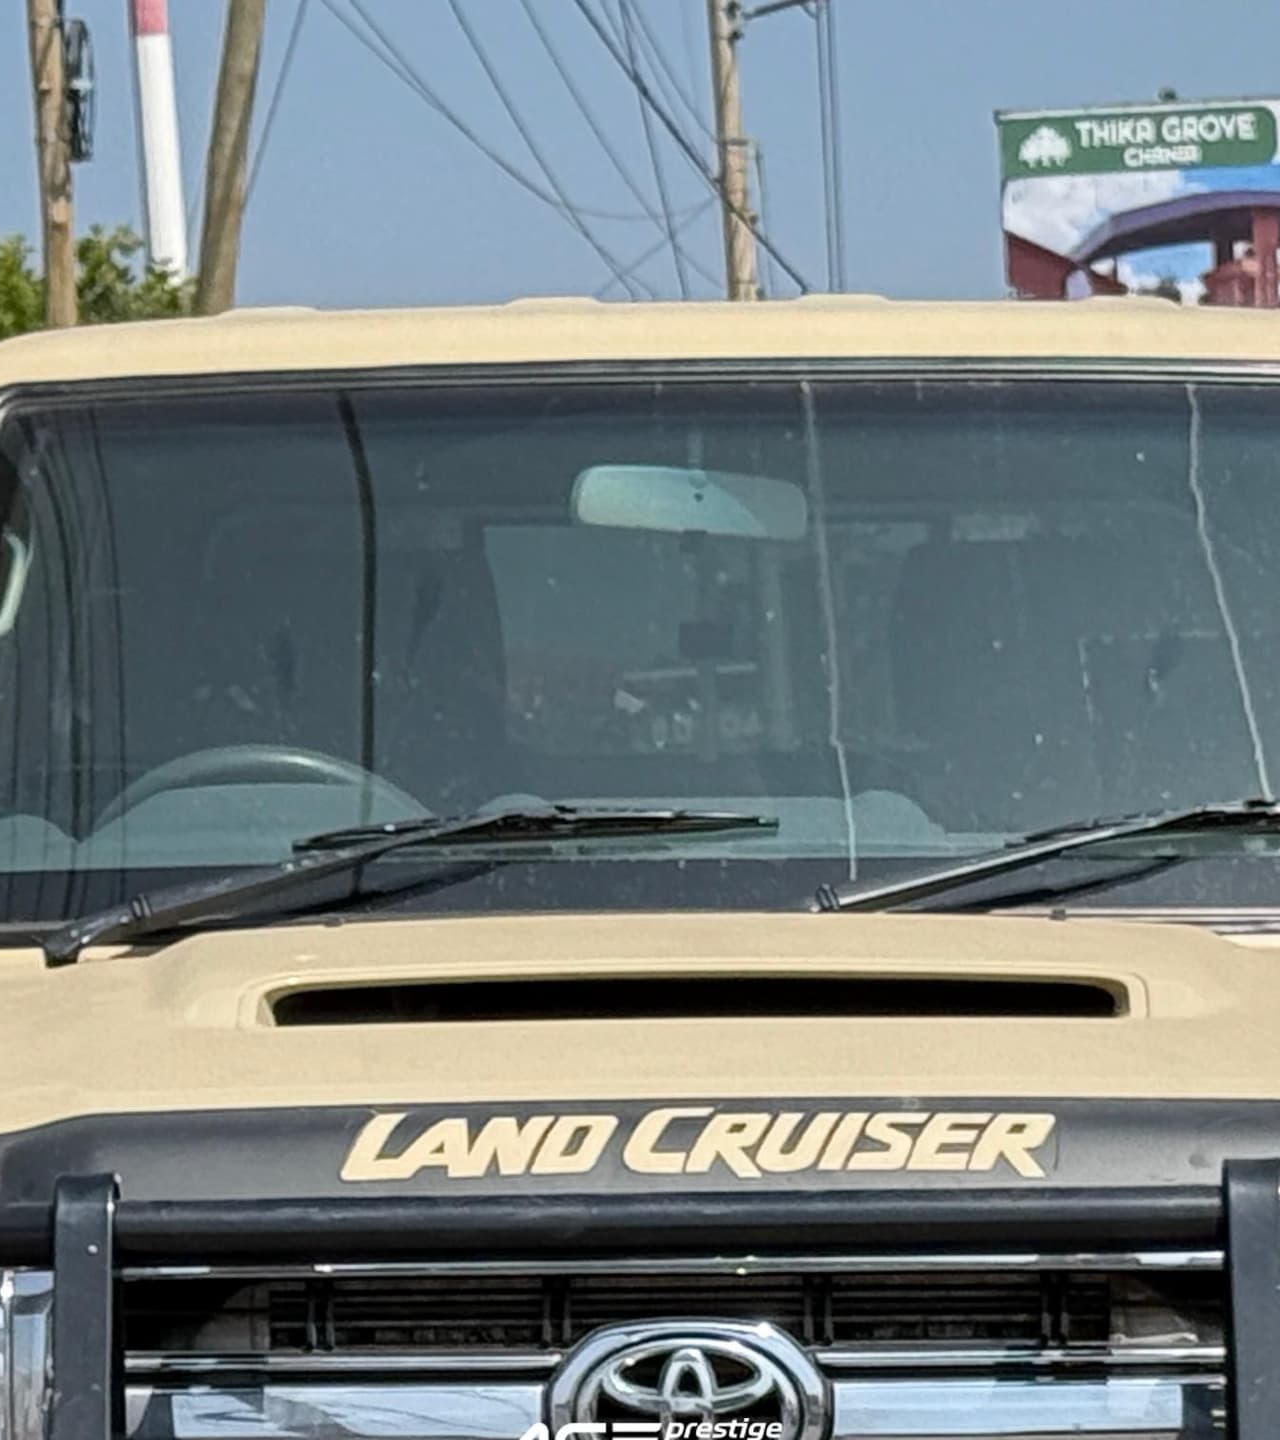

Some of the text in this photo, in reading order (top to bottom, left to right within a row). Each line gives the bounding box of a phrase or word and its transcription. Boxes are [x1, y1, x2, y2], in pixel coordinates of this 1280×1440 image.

[1074, 113, 1257, 148] THIKA GROVE
[339, 1107, 1056, 1182] LAND CRUISER
